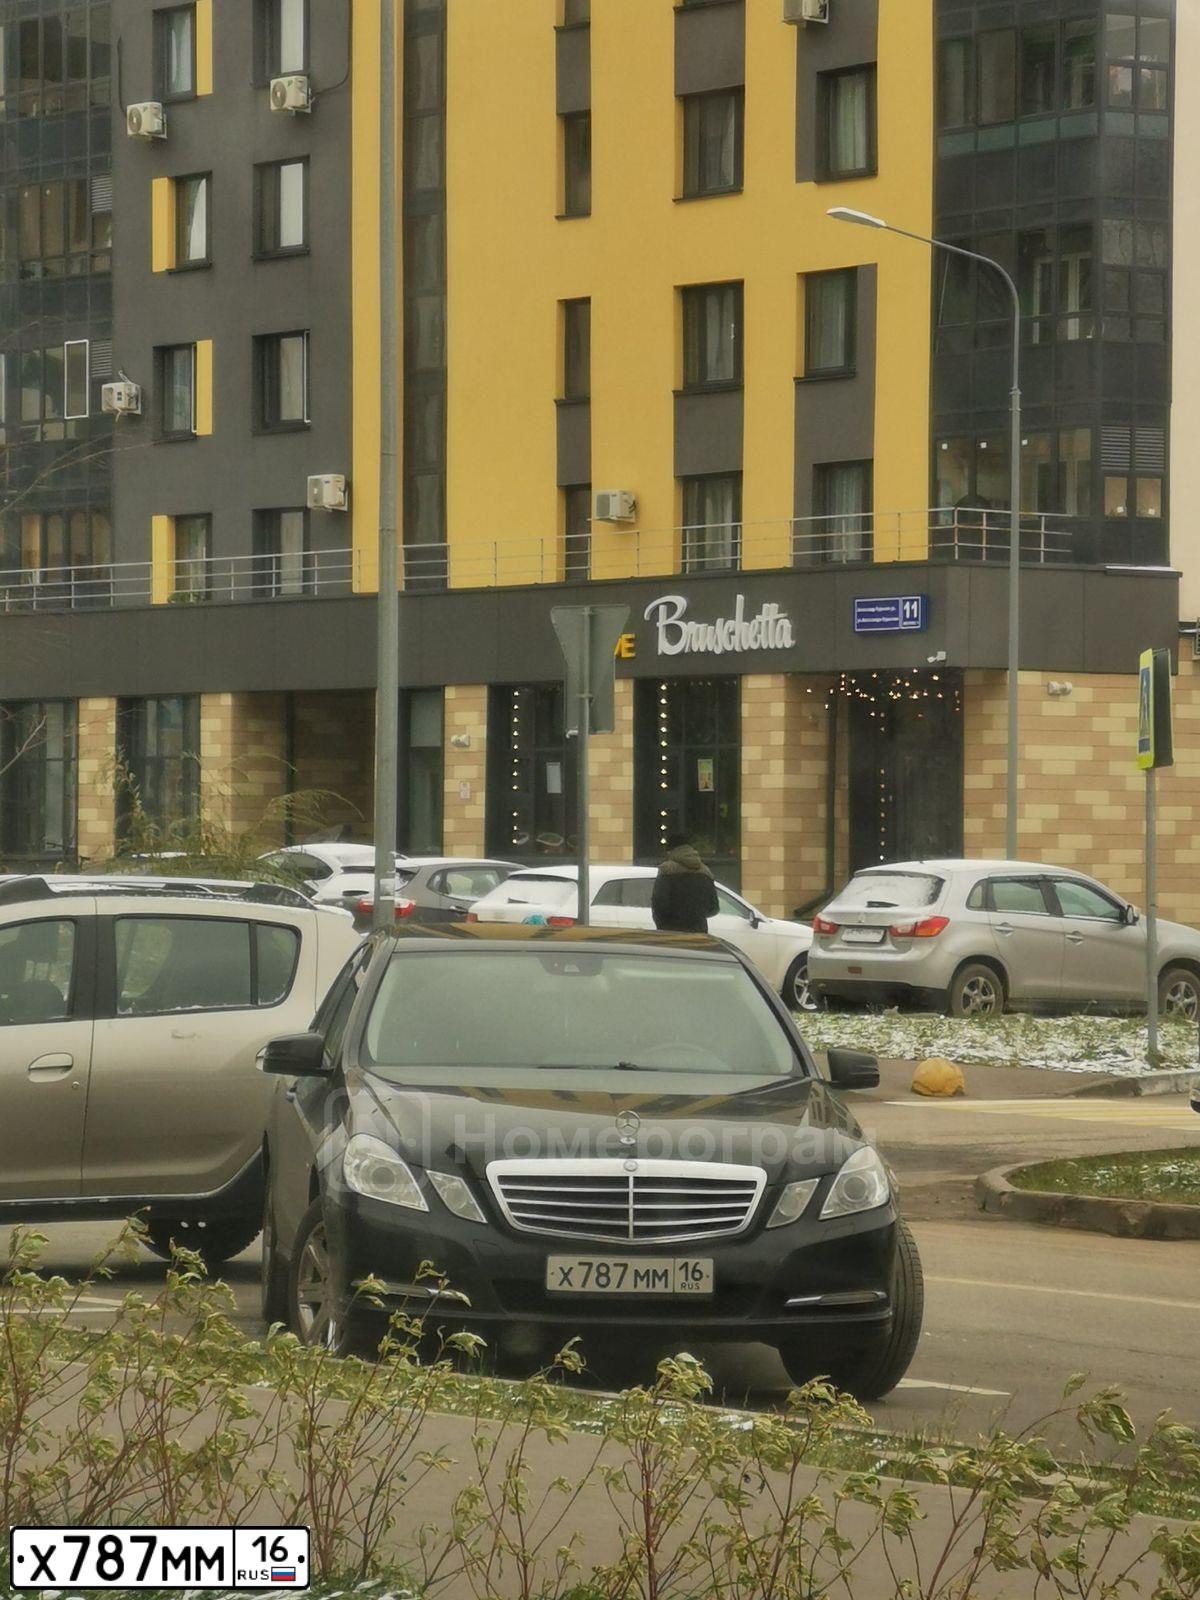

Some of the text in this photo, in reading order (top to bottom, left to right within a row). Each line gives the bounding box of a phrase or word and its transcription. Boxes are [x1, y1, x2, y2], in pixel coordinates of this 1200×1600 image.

[903, 601, 918, 619] 11
[644, 594, 795, 655] Bruschetta
[678, 1261, 704, 1282] 16
[680, 1282, 700, 1290] RUS
